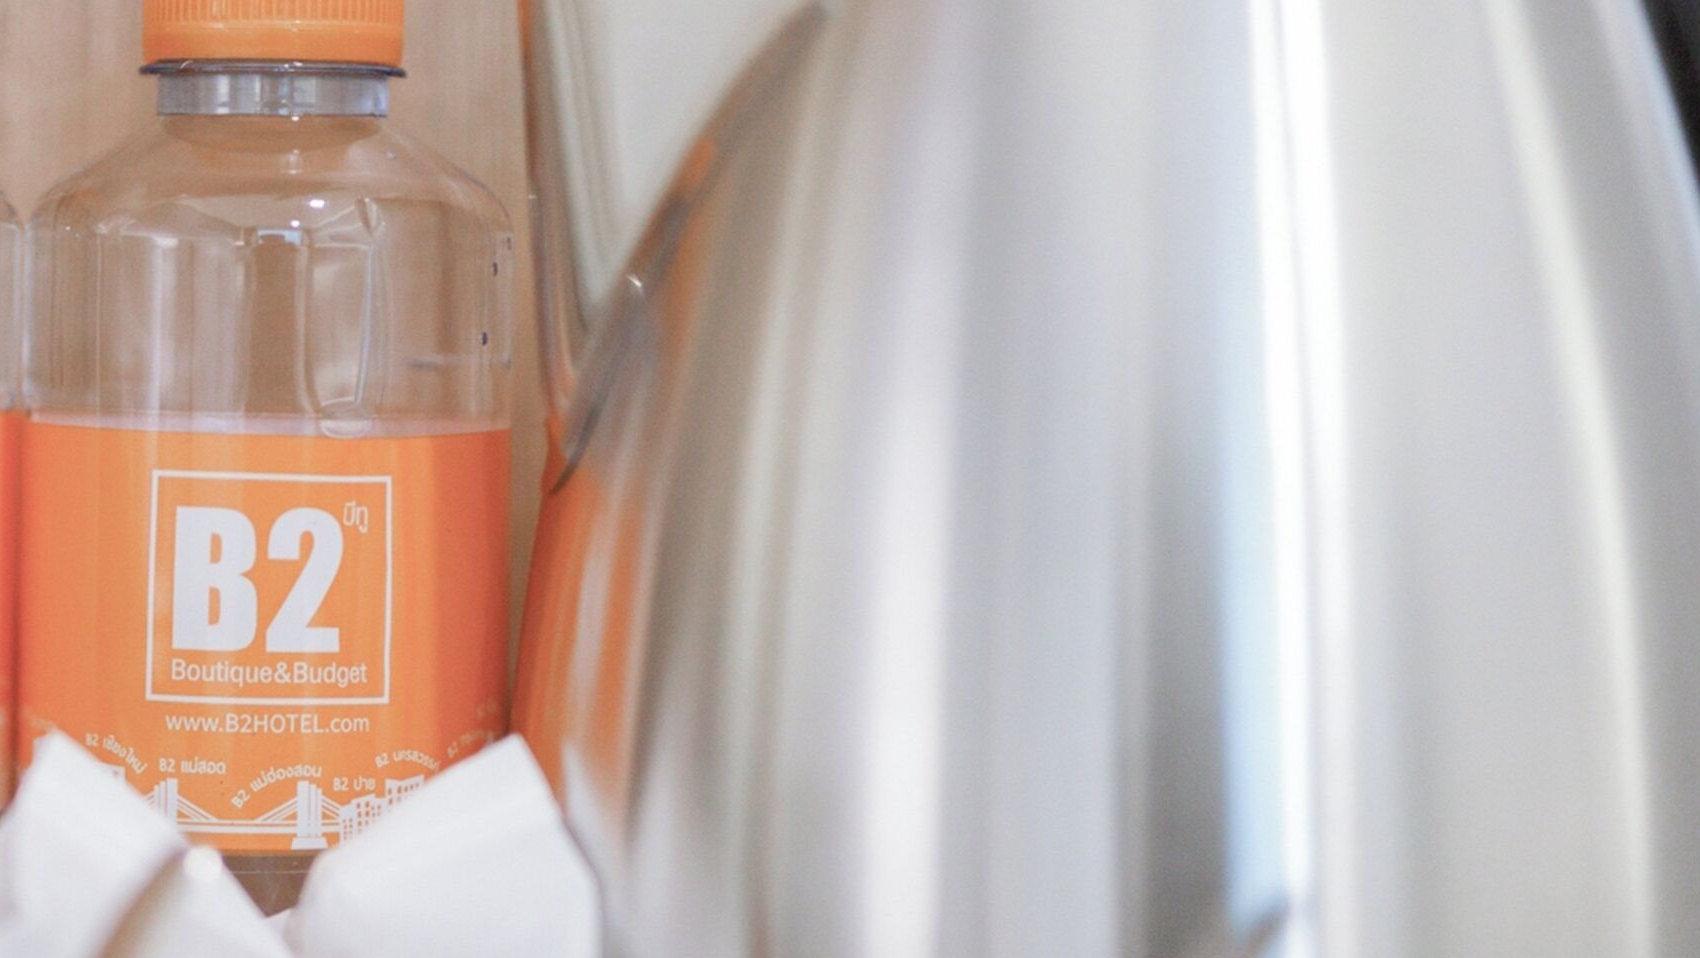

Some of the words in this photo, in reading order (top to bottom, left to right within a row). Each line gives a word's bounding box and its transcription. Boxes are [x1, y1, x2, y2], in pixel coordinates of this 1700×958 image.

[343, 501, 369, 533] บีทู
[172, 505, 344, 653] B2
[171, 659, 368, 688] Boutique&Budget
[165, 713, 370, 734] www.B2HOTEL.com
[158, 758, 175, 772] B2
[333, 777, 348, 791] B2
[231, 788, 249, 808] B2
